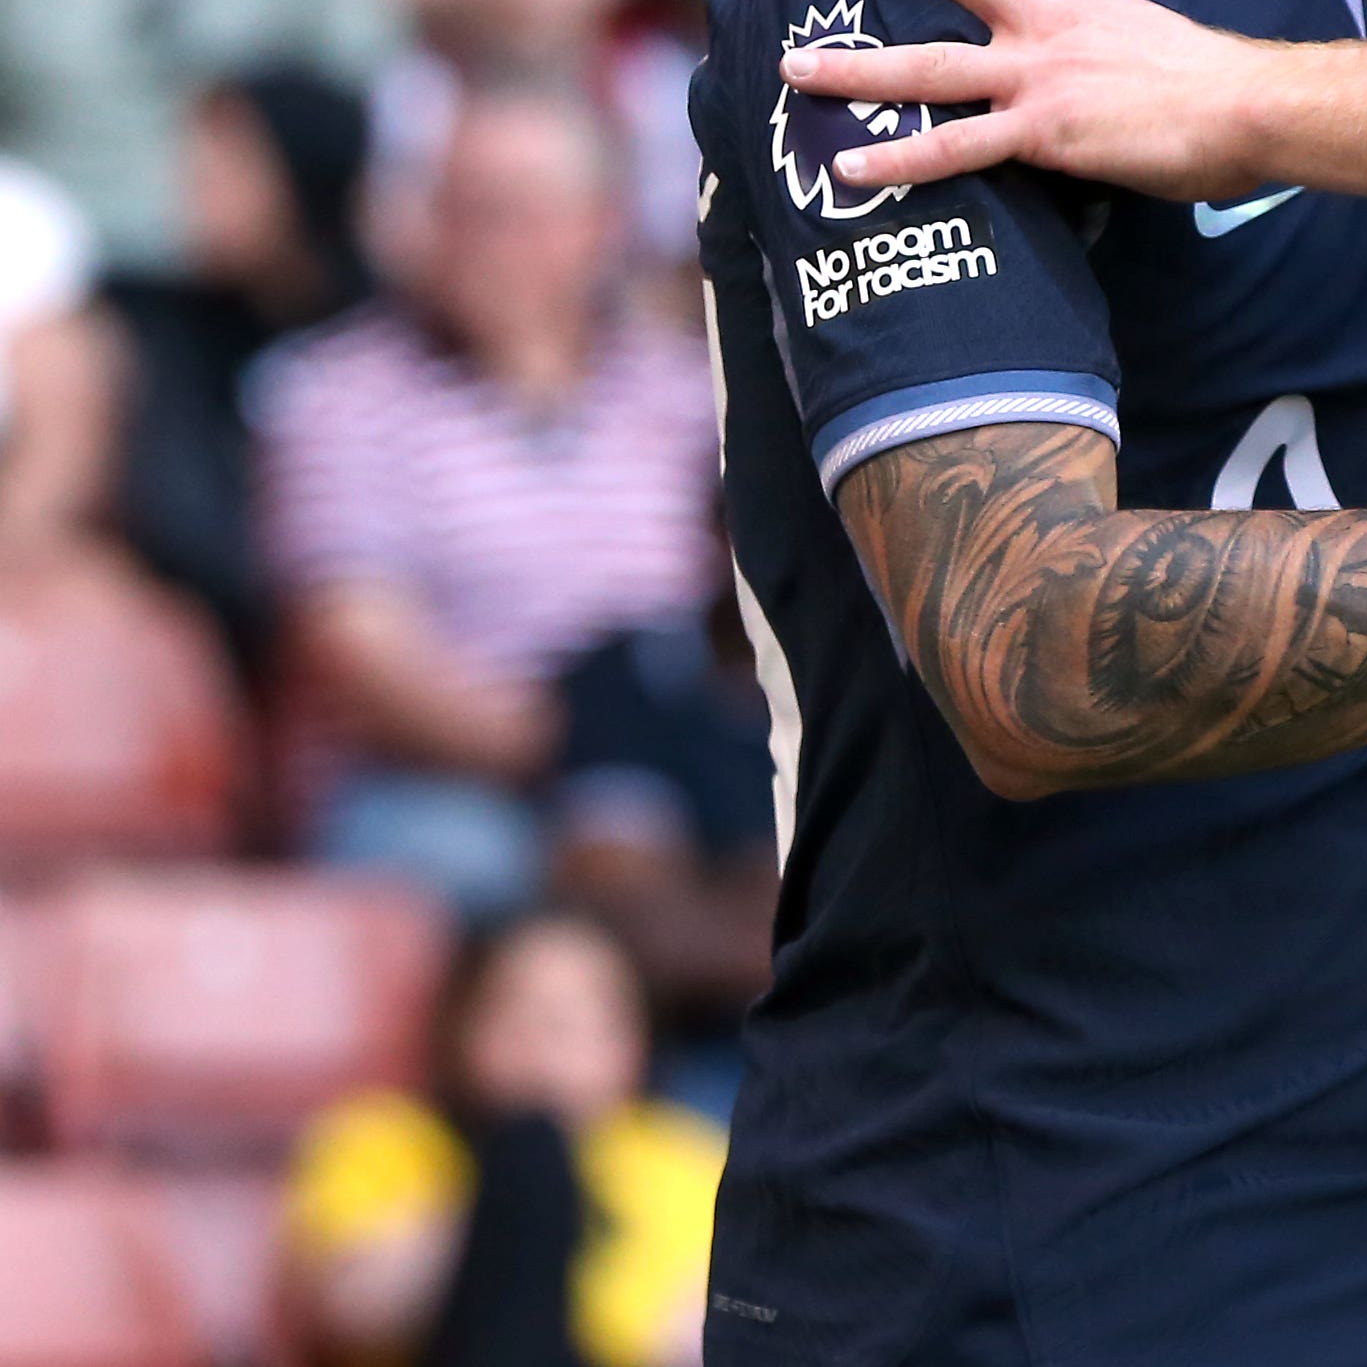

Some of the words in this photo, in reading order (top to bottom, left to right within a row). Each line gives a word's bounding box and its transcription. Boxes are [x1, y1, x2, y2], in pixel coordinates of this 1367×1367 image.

[795, 248, 850, 293] No
[855, 217, 972, 270] room
[802, 281, 854, 328] for
[858, 246, 997, 304] racism
